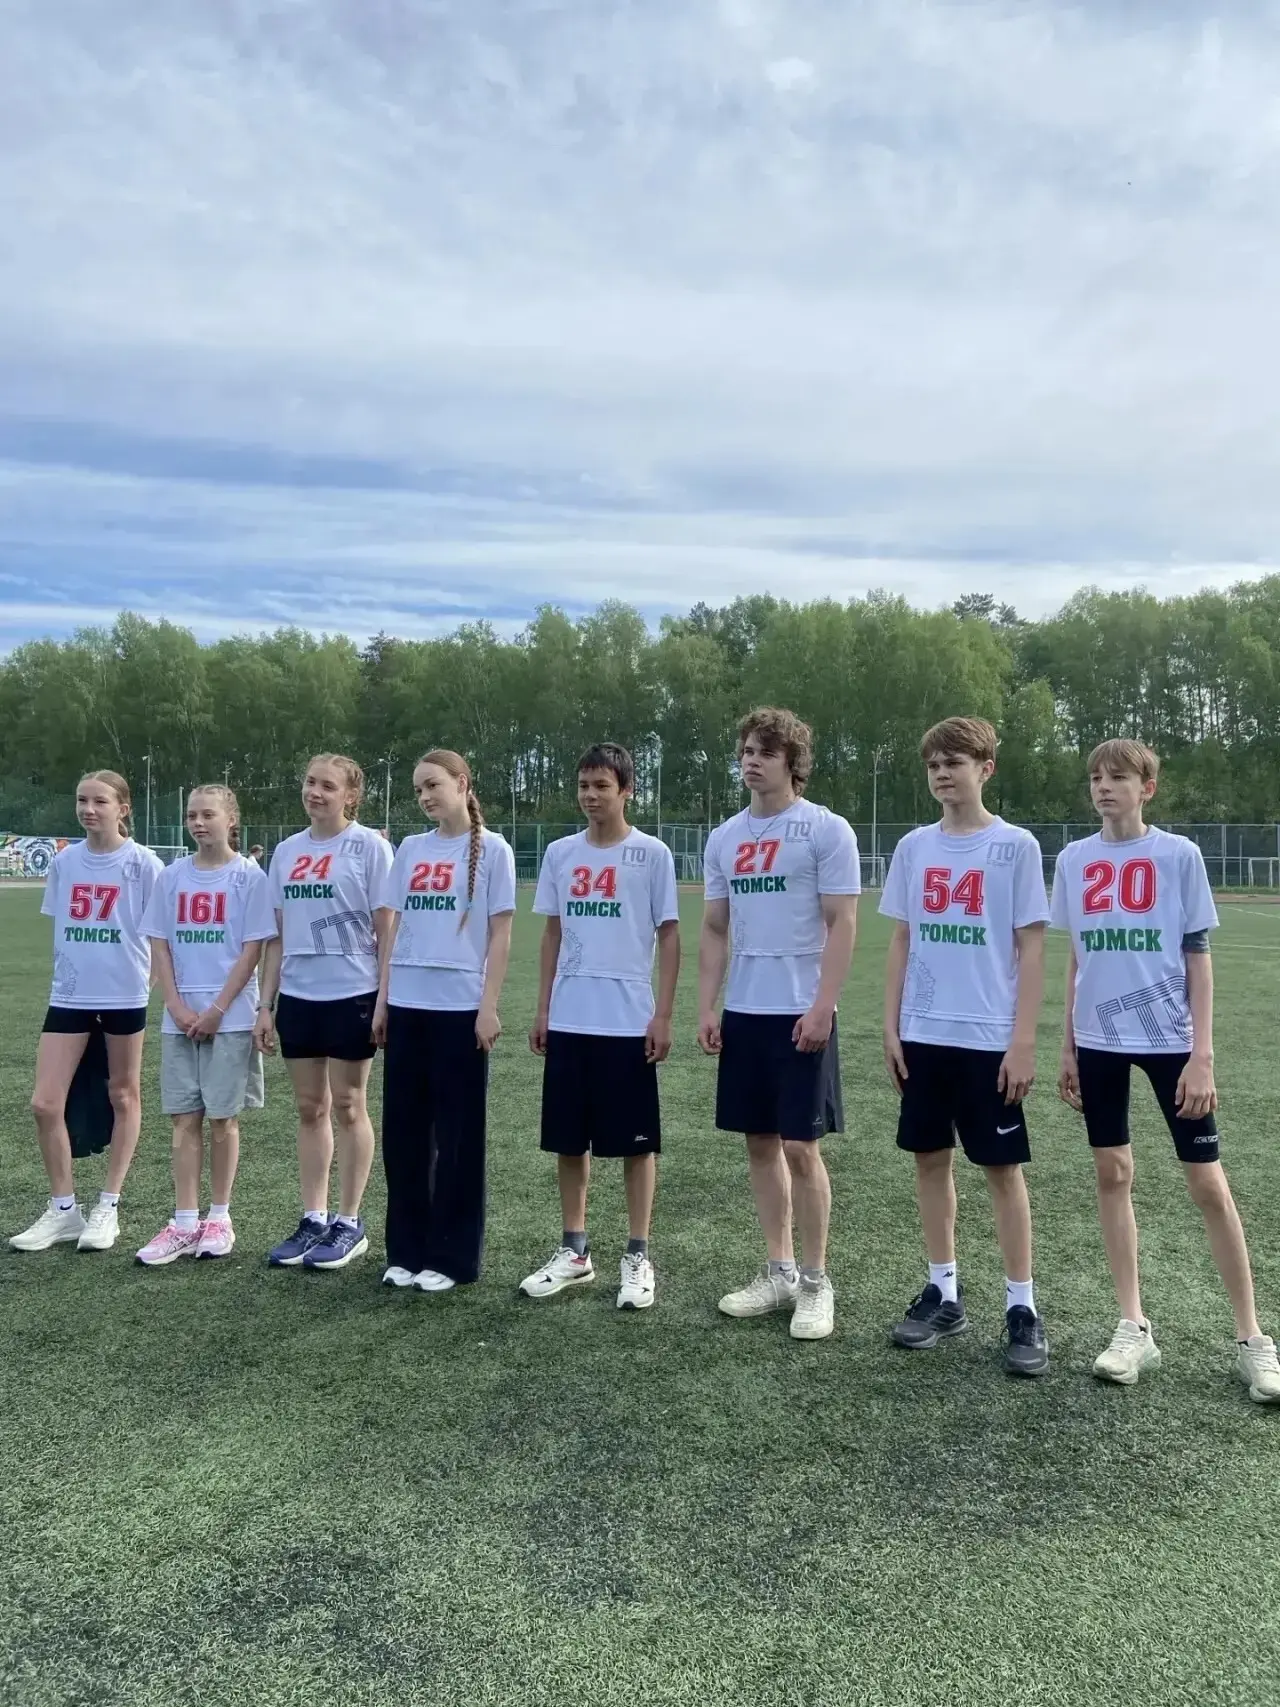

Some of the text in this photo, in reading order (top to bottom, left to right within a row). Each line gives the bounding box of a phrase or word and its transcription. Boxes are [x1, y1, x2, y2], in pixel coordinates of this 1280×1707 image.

[288, 854, 333, 881] 24
[734, 839, 780, 875] 27
[284, 884, 334, 899] ТОМСК
[409, 863, 455, 892] 25
[570, 866, 616, 898] 34
[731, 876, 786, 894] ТОМСК
[923, 868, 984, 915] 54
[1083, 858, 1155, 914] 20
[69, 884, 120, 920] 57
[177, 892, 226, 924] 161
[65, 926, 121, 944] ТОМСК
[176, 930, 224, 944] ТОМСК
[920, 923, 986, 945] ТОМСК
[1080, 928, 1162, 952] ТОМСК
